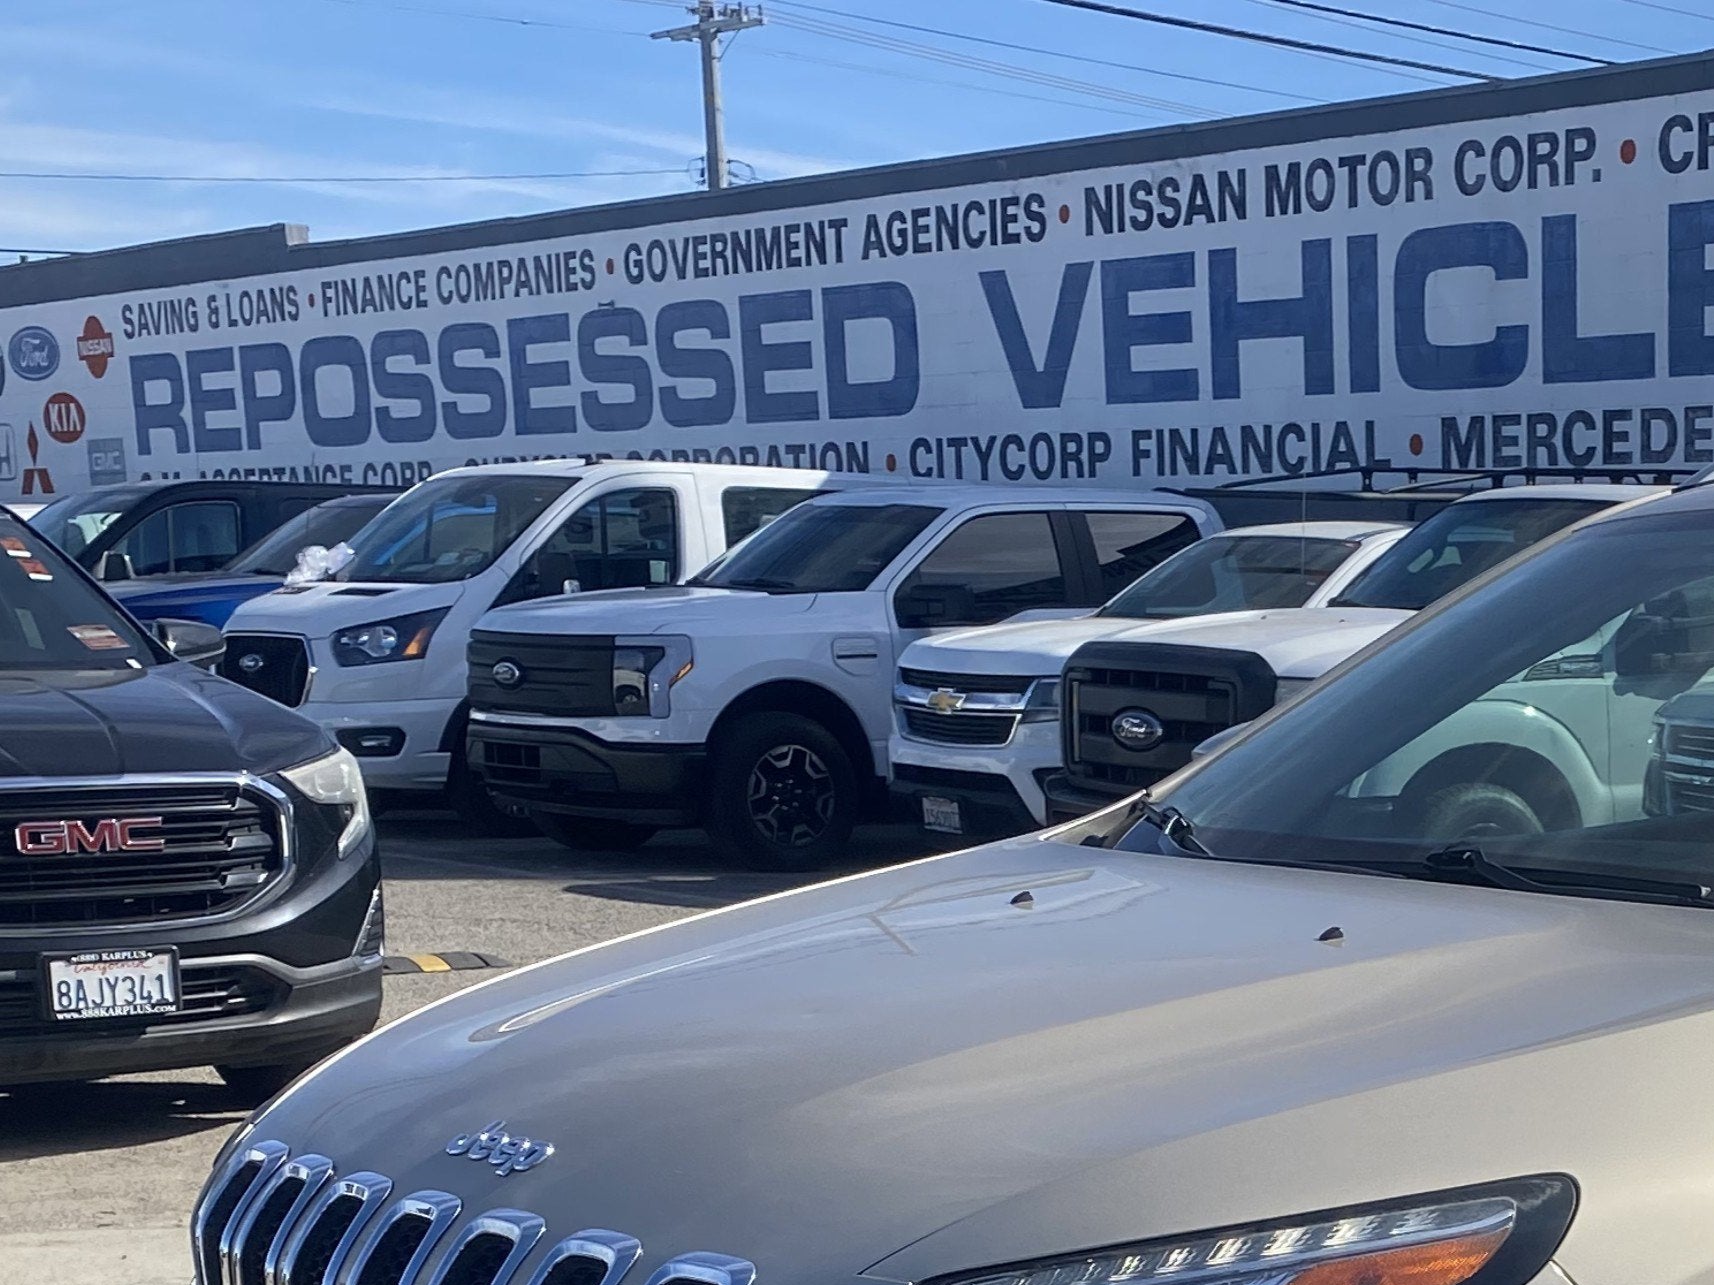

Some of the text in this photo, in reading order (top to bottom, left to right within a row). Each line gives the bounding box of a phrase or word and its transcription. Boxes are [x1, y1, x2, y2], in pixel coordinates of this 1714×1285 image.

[121, 296, 199, 340] SAVING
[208, 297, 220, 330] &
[227, 285, 301, 328] LOANS
[321, 270, 428, 318] FINANCE
[436, 248, 596, 306] COMPANIES
[623, 218, 848, 285] GOVERNMENT
[861, 192, 1048, 261] AGENCIES
[1084, 168, 1248, 237] NISSAN
[1265, 146, 1434, 218] MOTOR
[1453, 126, 1602, 197] CORP.
[129, 279, 920, 457] REPOSSESSED
[49, 402, 82, 433] KIA
[908, 431, 1112, 481] CITYCORP
[1132, 420, 1391, 478] FINANCIAL
[15, 815, 166, 855] GMC
[56, 973, 171, 1009] 8AJY341
[445, 1120, 555, 1176] Jeep
